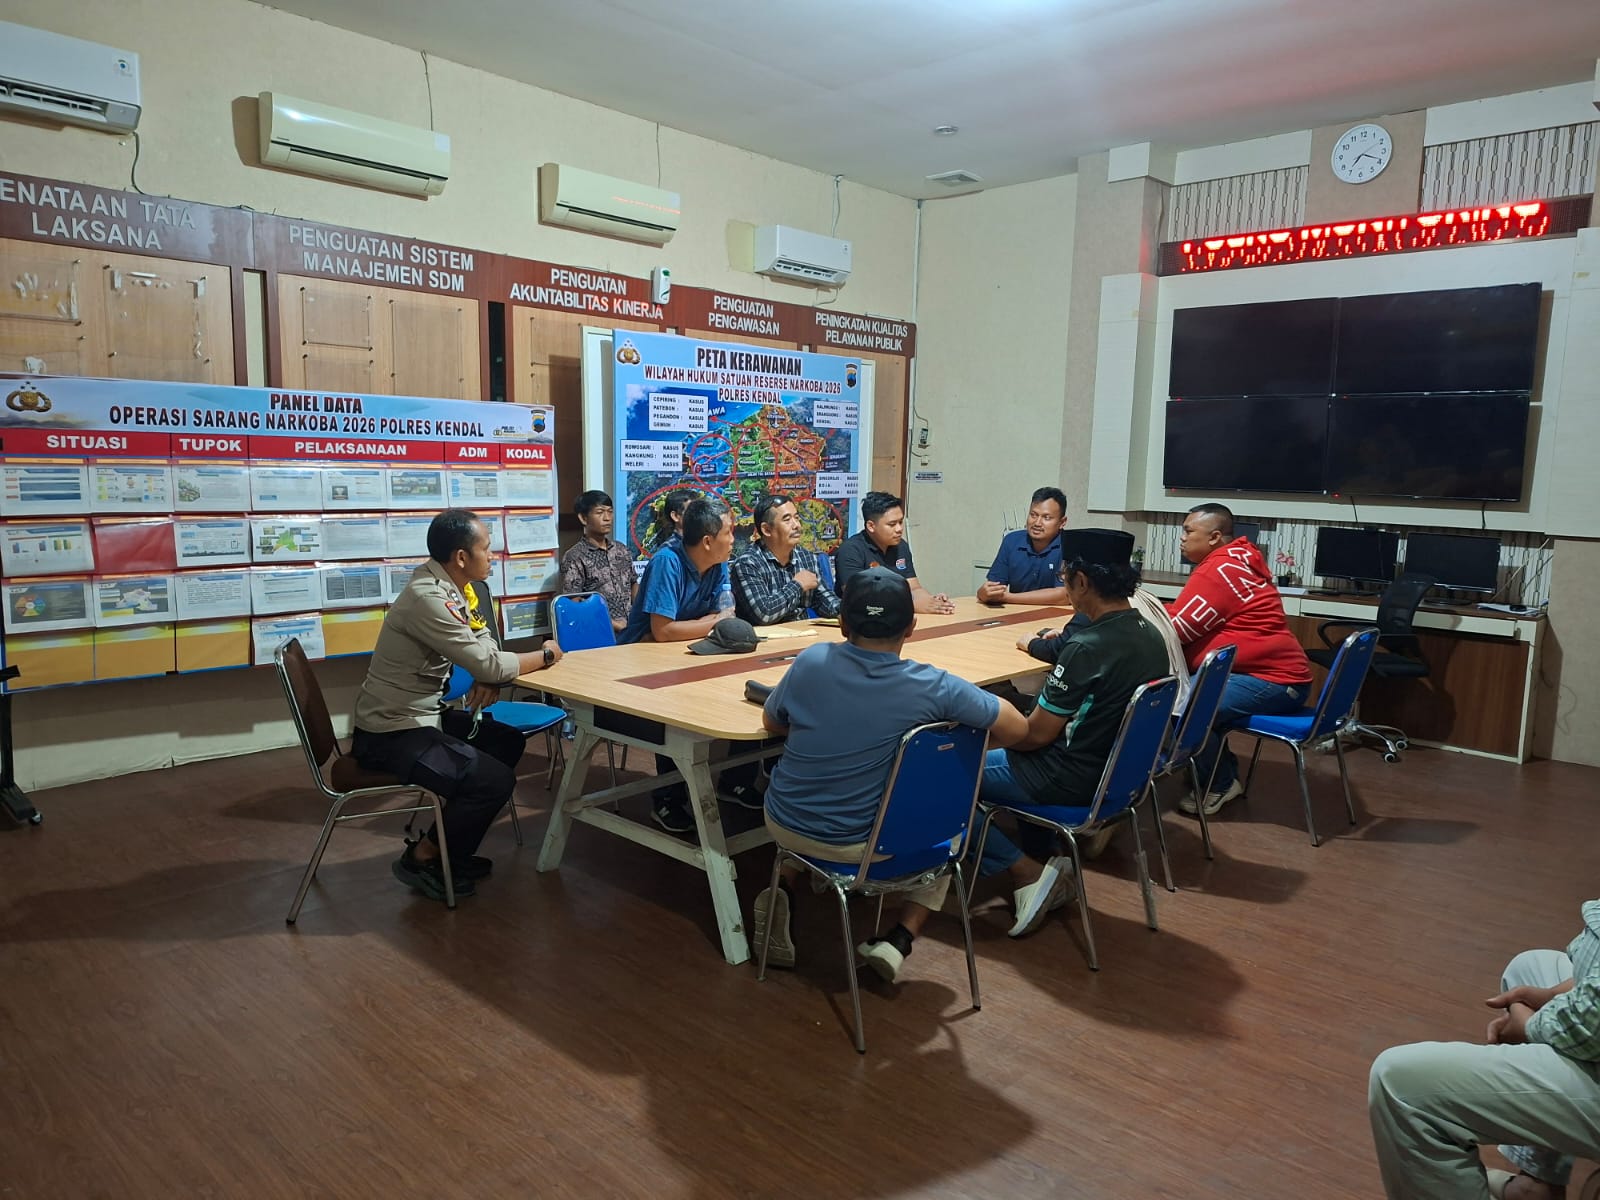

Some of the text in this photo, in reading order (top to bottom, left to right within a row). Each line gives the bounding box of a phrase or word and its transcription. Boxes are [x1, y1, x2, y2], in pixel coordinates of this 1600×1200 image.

[140, 201, 196, 229] TATA
[32, 212, 162, 250] LAKSANA
[289, 224, 474, 272] PENGUATAN SISTEM
[303, 252, 465, 292] MANAJEMEN SDM
[551, 268, 627, 295] PENGUATAN
[510, 283, 664, 320] AKUNTABILITAS KINERJA
[713, 295, 774, 318] PENGUATAN
[708, 313, 780, 336] PENGAWASAN
[815, 312, 908, 338] PENINGKATAN KUALITAS
[826, 330, 903, 351] PELAYANAN PUBLIK
[697, 348, 802, 376] PETA KERAWANAN
[645, 364, 841, 395] WILAYAH HUKUM SATUAN RESERSE NARKOBA 2026
[270, 393, 363, 414] PANEL DATA
[718, 387, 782, 404] POLRES KENDAL
[109, 405, 187, 426] OPERASI
[192, 409, 260, 429] SARANG
[265, 412, 338, 432] NARKOBA
[343, 417, 376, 434] 2026
[380, 418, 431, 435] POLRES
[435, 420, 484, 437] KENDAL
[46, 435, 546, 460] SITUASI TUPOK PELAKSANAAN ADM KODAL
